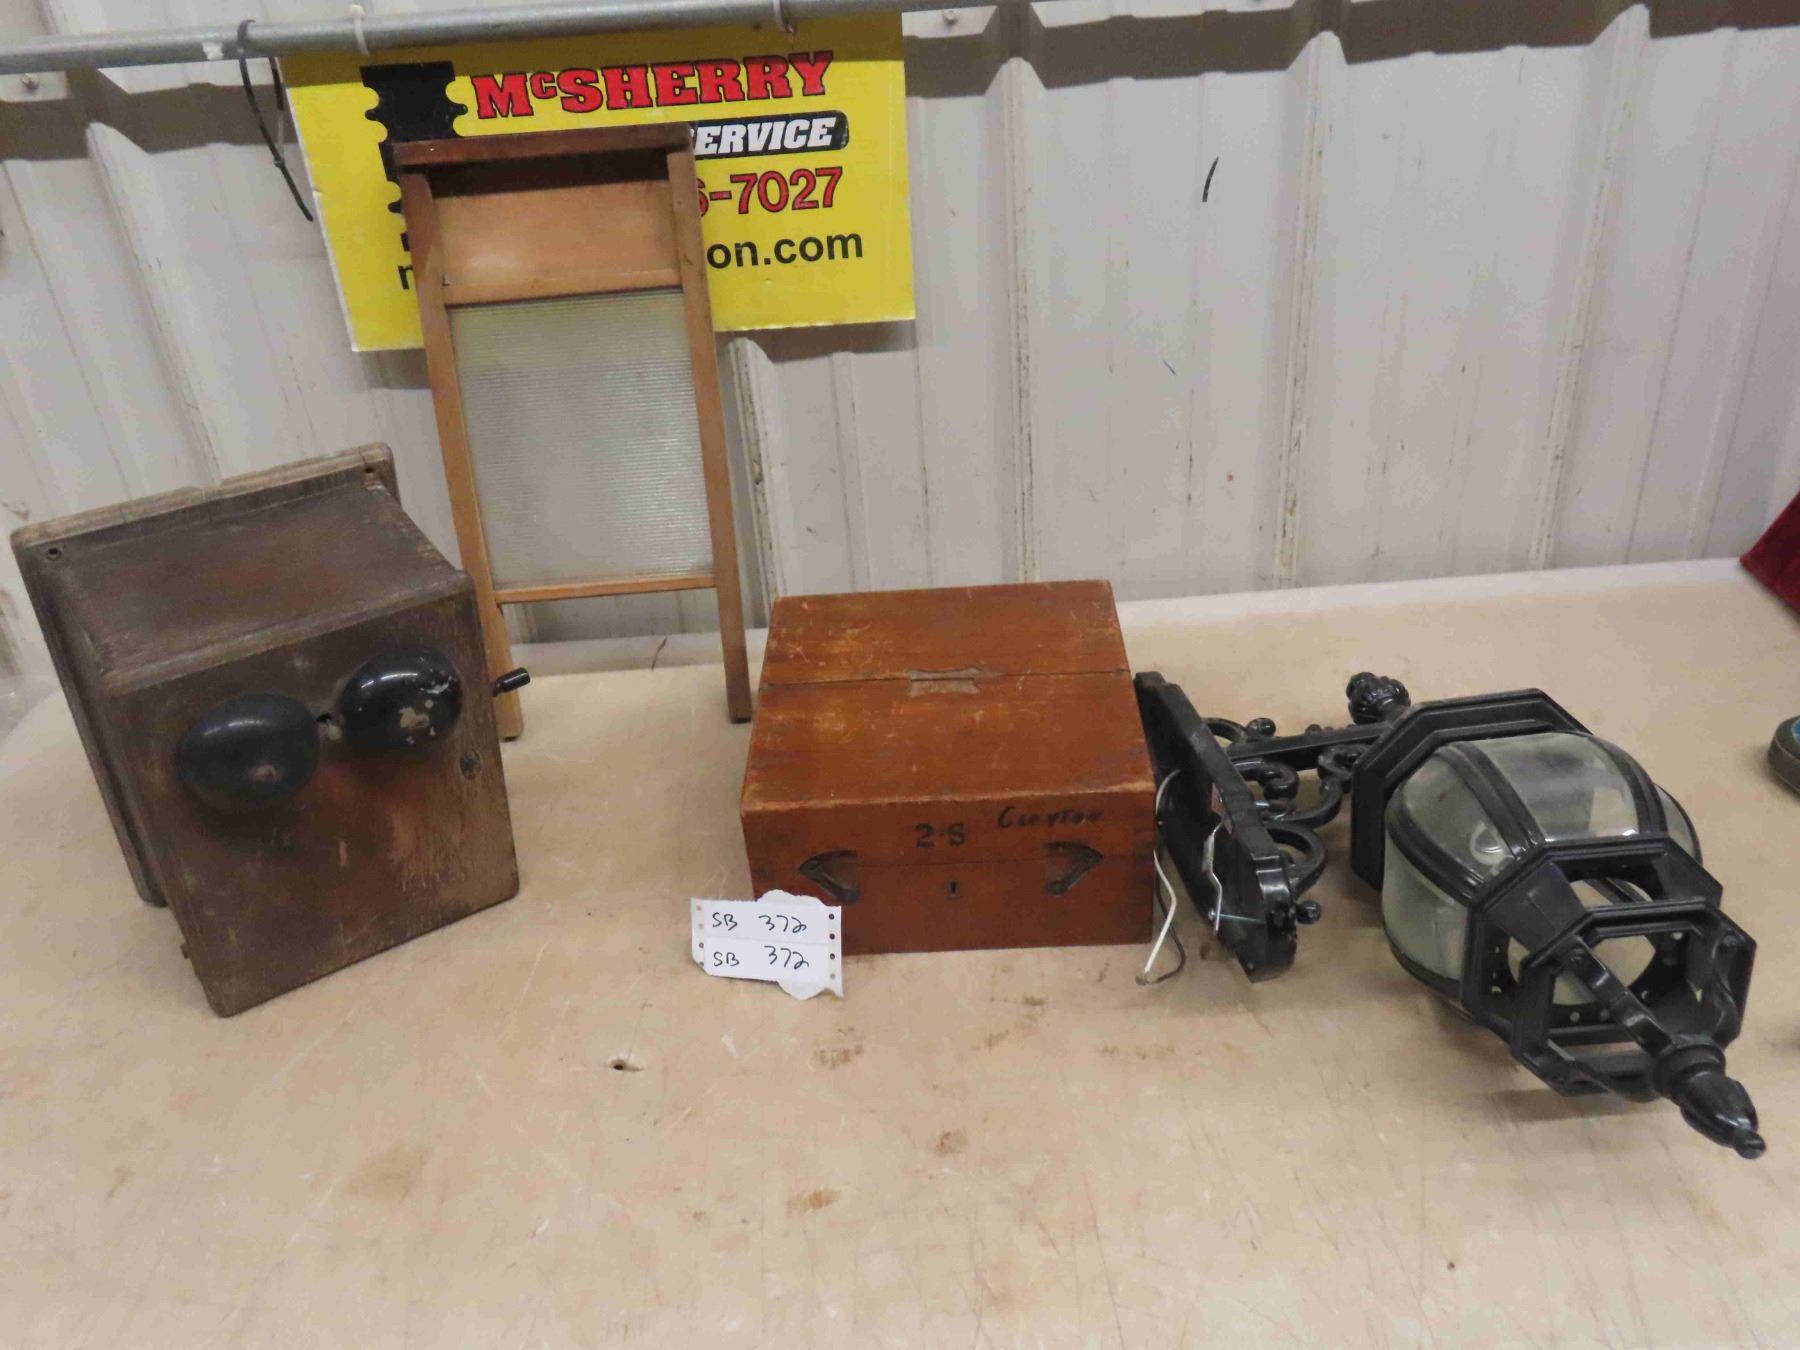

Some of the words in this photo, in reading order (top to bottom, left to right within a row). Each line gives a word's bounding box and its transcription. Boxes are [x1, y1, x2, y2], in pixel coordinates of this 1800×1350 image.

[692, 118, 837, 156] ERVICE
[706, 233, 862, 269] on.com
[712, 912, 738, 931] SB
[758, 914, 807, 933] 372
[713, 951, 740, 967] SB
[763, 945, 810, 970] 372
